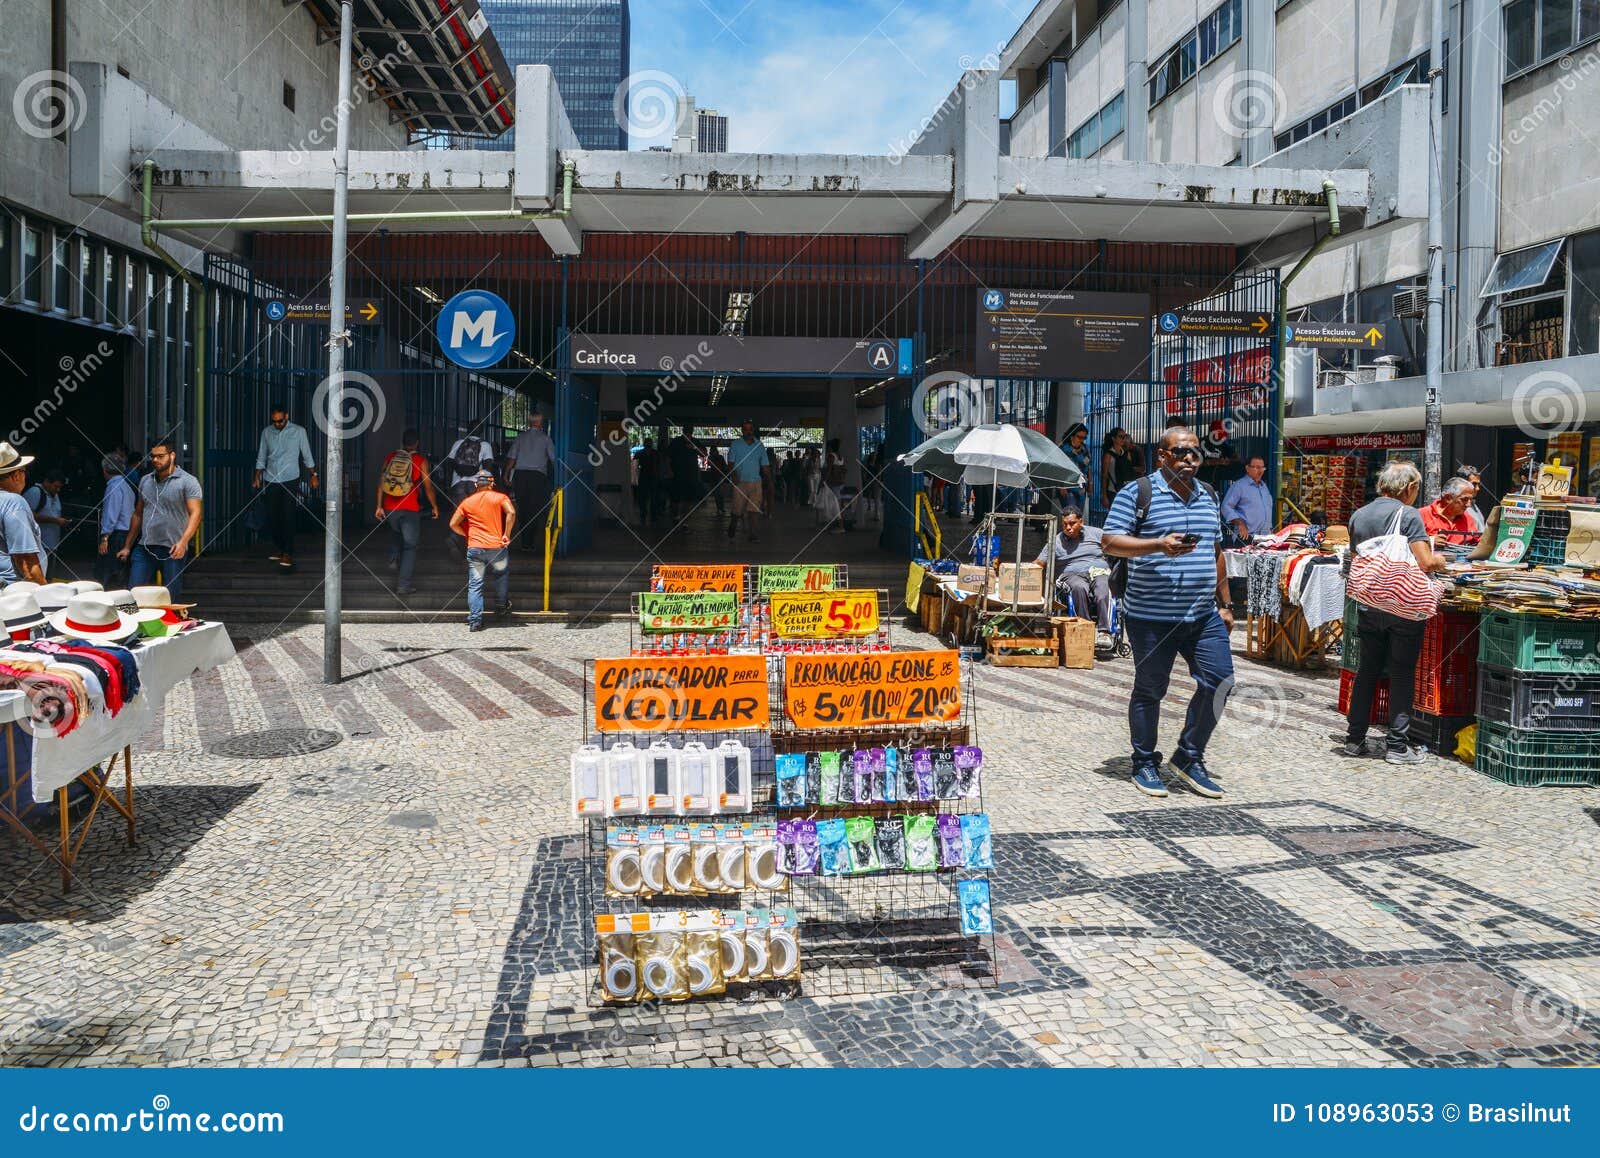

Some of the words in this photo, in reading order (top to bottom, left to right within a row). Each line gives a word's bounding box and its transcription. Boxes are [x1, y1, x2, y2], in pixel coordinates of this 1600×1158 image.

[287, 303, 313, 311] Acesso
[315, 303, 350, 311] Exclo
[1182, 315, 1207, 323] Acesso
[1208, 316, 1243, 324] Exclusivo
[1295, 327, 1320, 335] Acesso
[1322, 328, 1356, 336] Exclusivo
[576, 349, 636, 365] Carioca
[873, 347, 890, 366] A
[1336, 434, 1382, 448] Disk-Entrega
[1383, 432, 1422, 446] 2544-3000
[1505, 507, 1535, 516] Promoção
[661, 568, 694, 580] PROMOÇÃO
[697, 569, 709, 579] PEN
[712, 569, 736, 580] DRIVE
[764, 568, 800, 579] PROMOÇÃO
[763, 578, 774, 587] PEN
[775, 578, 798, 588] DRIVE
[647, 599, 683, 616] CARTÃO
[785, 615, 823, 625] CELULAR
[786, 624, 817, 633] TABLET
[793, 657, 883, 684] PROMOÇÃO
[889, 657, 936, 680] FONE
[942, 661, 953, 671] DE
[599, 665, 728, 689] CARREGADOR
[733, 669, 760, 682] PARA
[601, 693, 759, 721] CELULAR
[793, 697, 807, 718] R$
[1574, 697, 1584, 708] SFP
[939, 752, 951, 760] RO
[785, 758, 797, 766] RO
[883, 820, 896, 828] RO
[948, 818, 959, 826] RO
[802, 824, 814, 832] RO
[968, 884, 980, 892] RO
[678, 911, 687, 926] 3
[712, 909, 721, 925] 3
